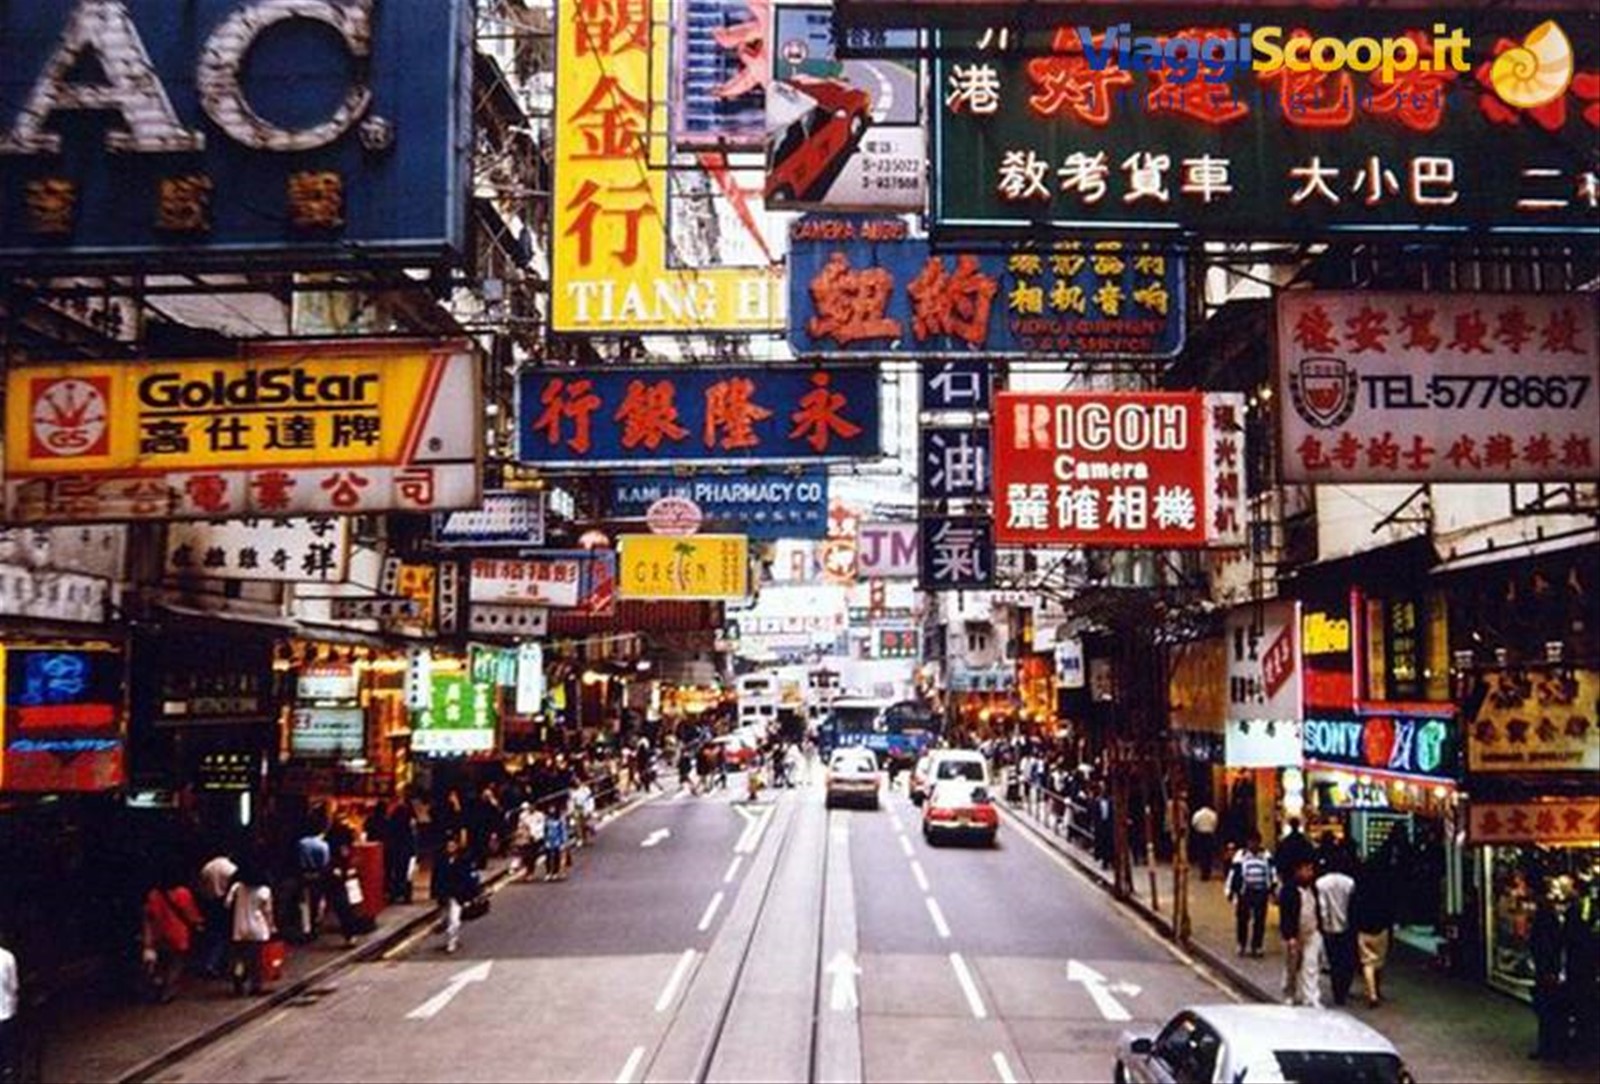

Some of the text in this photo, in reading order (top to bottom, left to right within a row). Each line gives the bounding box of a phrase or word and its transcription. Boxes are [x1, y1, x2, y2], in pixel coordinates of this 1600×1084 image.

[1290, 155, 1459, 203] 大小巴
[567, 278, 716, 322] TIANG
[808, 252, 1000, 344] 紐約
[138, 368, 379, 409] GoldStar
[49, 430, 88, 448] GS
[139, 414, 381, 454] 高仕達牌
[1013, 402, 1188, 451] RICOH
[1053, 455, 1149, 480] Camera
[694, 482, 793, 503] PHARMACY
[796, 483, 821, 502] CO
[1006, 483, 1197, 531] 麗確相機
[634, 561, 708, 583] GREEN
[1305, 719, 1361, 757] SONY
